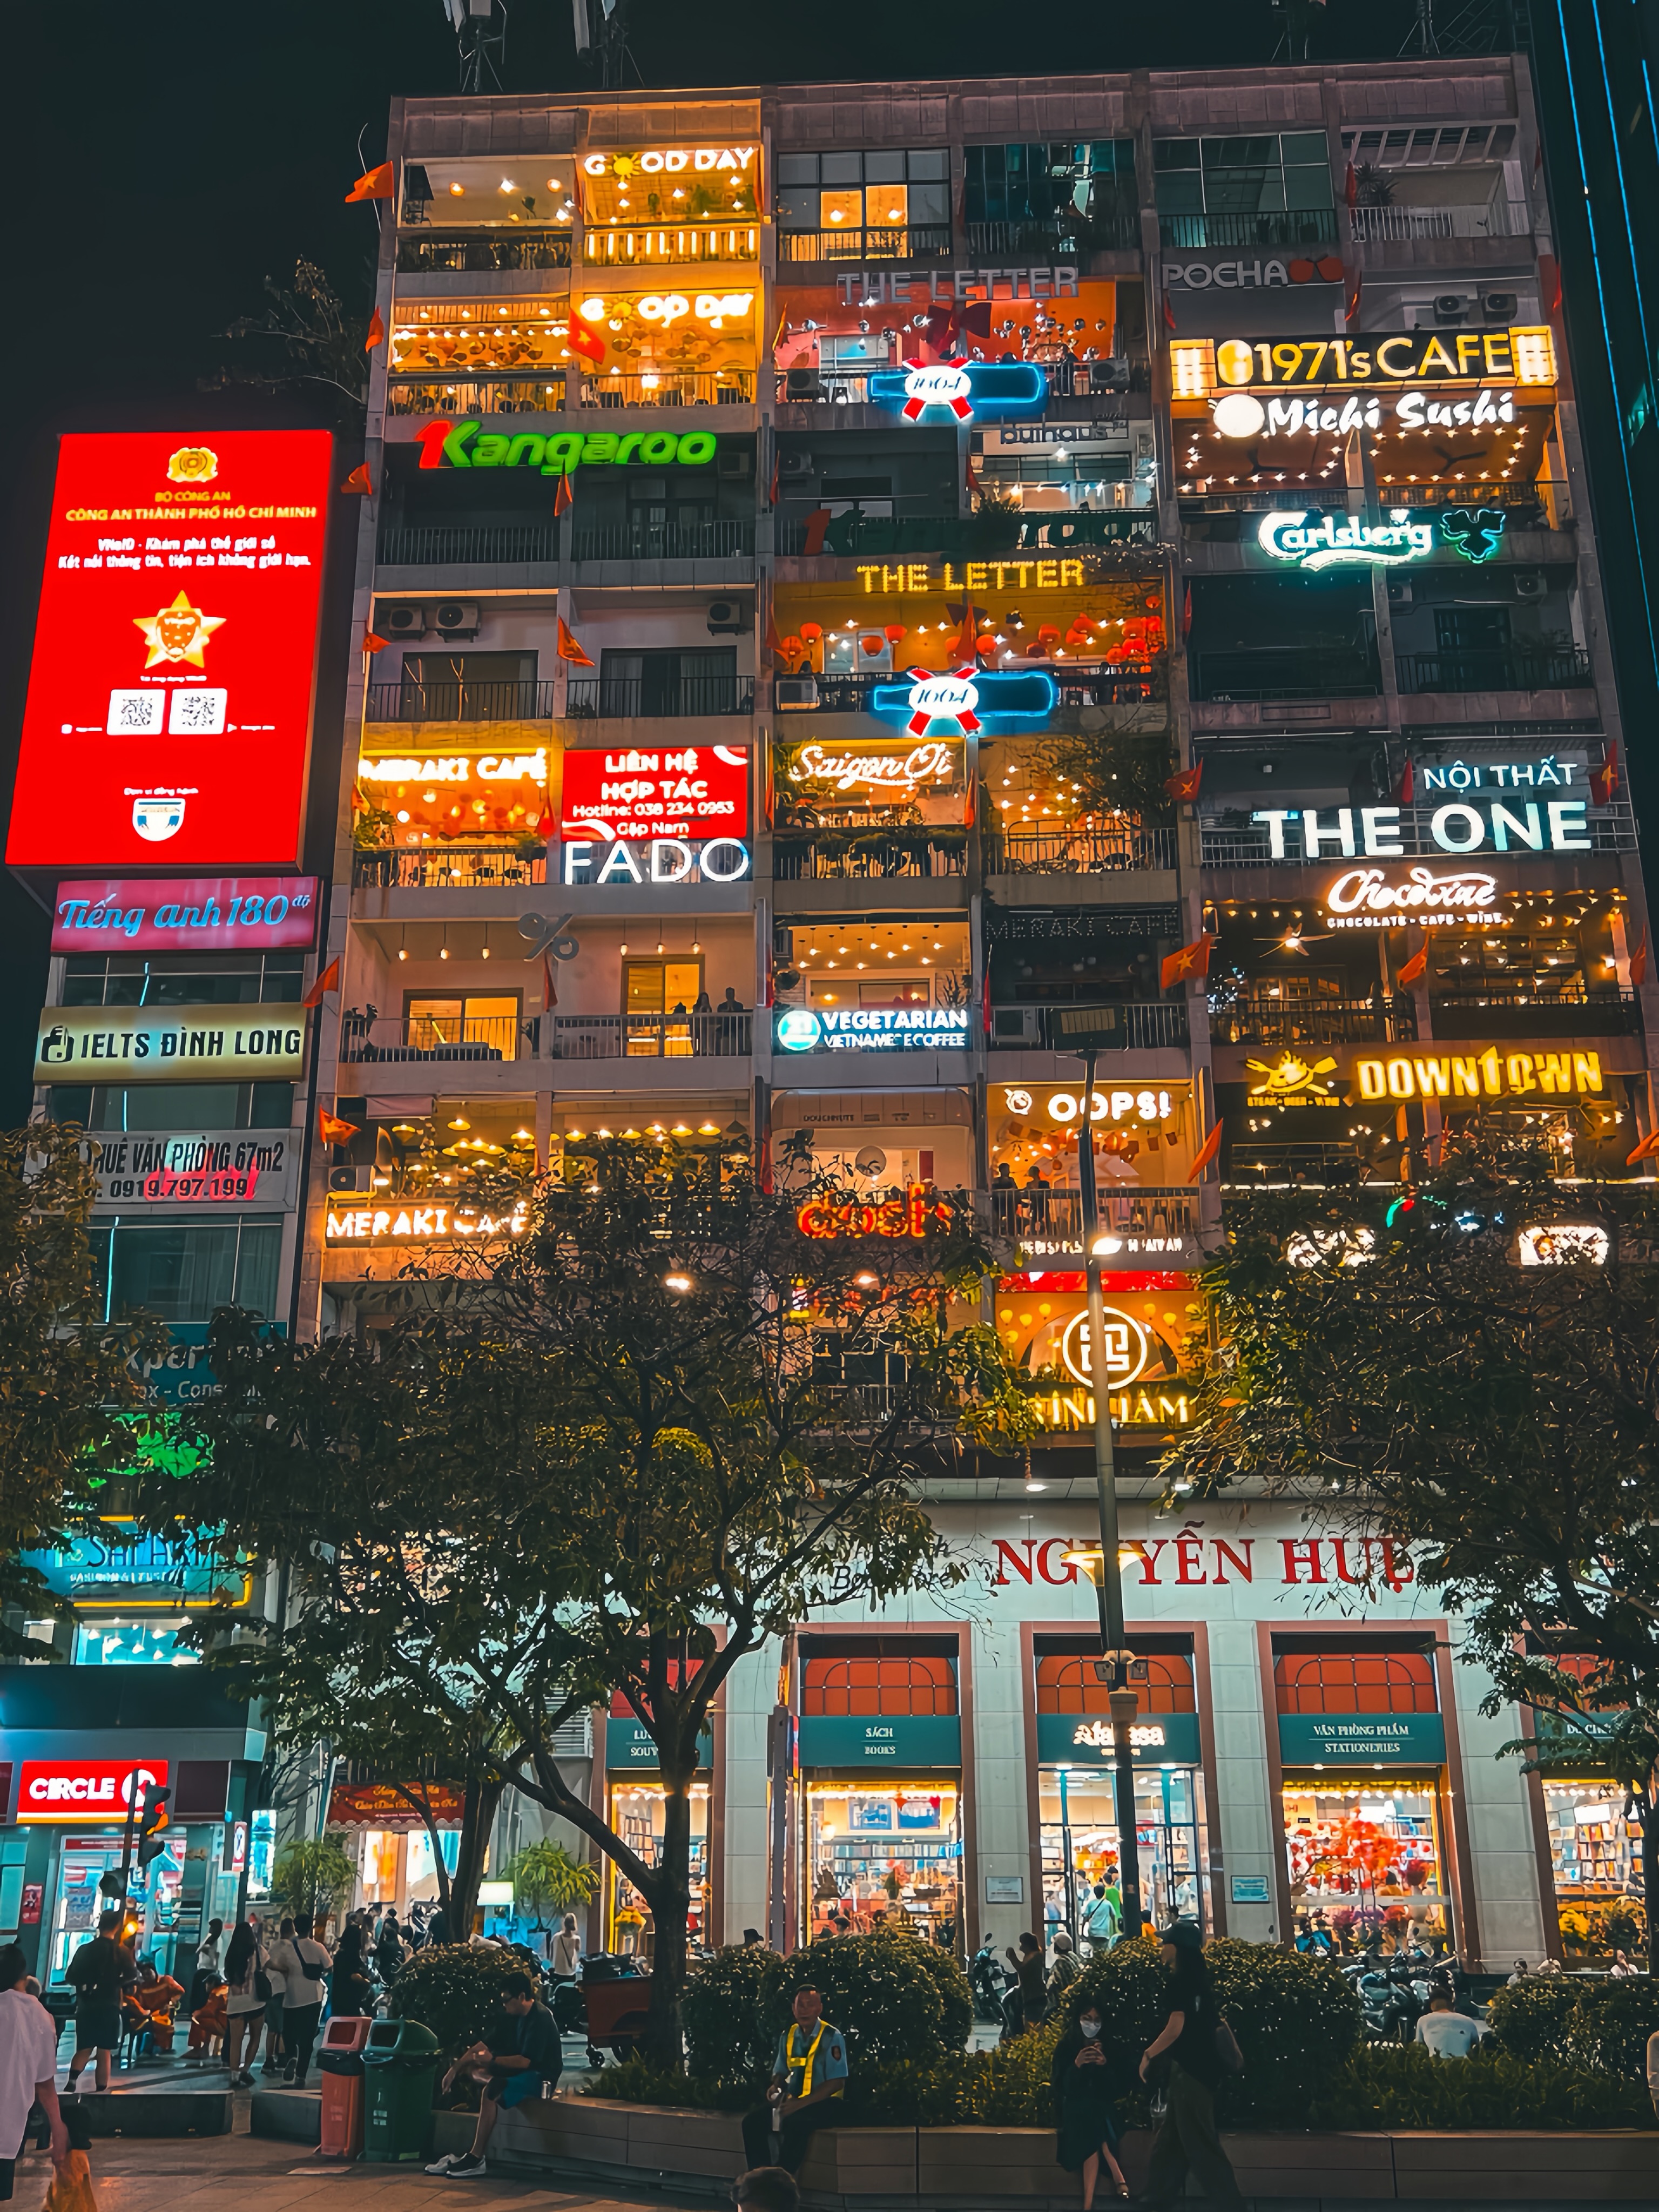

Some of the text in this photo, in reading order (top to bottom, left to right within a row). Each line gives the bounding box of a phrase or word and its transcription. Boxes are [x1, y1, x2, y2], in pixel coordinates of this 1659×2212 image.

[695, 147, 753, 171] DAY
[837, 267, 1079, 304] THE LETTER
[1163, 260, 1289, 291] POCHA
[1377, 333, 1513, 378] CAFE
[1267, 390, 1513, 436] Michi Sushi
[212, 491, 231, 501] AN
[65, 508, 108, 521] CÔNG
[110, 509, 132, 520] AN
[276, 507, 316, 517] MINH
[1259, 509, 1432, 566] Carlsberg
[857, 559, 1084, 593] THE LETTER
[918, 688, 969, 704] 1004
[605, 748, 699, 774] LIÊN HỆ
[1424, 755, 1577, 793] NỘI THẤT
[601, 777, 708, 804] HỢP TÁC
[572, 804, 631, 818] Hotline:
[666, 801, 694, 815] 234
[652, 822, 690, 834] Nam
[1252, 800, 1592, 858] THE ONE
[565, 838, 749, 885] FADO
[58, 893, 145, 937] Tiếng
[153, 897, 220, 928] anh
[226, 895, 288, 927] 180
[986, 918, 1095, 941] MERAKI
[1327, 915, 1407, 929] CHOCOLATE
[822, 1009, 968, 1030] VEGETARIAN
[81, 1026, 301, 1060] IELTS ĐÌNH LONG
[1357, 1045, 1603, 1100] DOWNTOWN
[1048, 1090, 1172, 1123] OOPS!
[93, 1135, 285, 1175] HUÊ VĂN PHÒNG 67m2
[110, 1178, 248, 1198] 0919.797.199
[327, 1209, 448, 1237] MERAKI
[29, 1777, 116, 1800] CIRCLE
